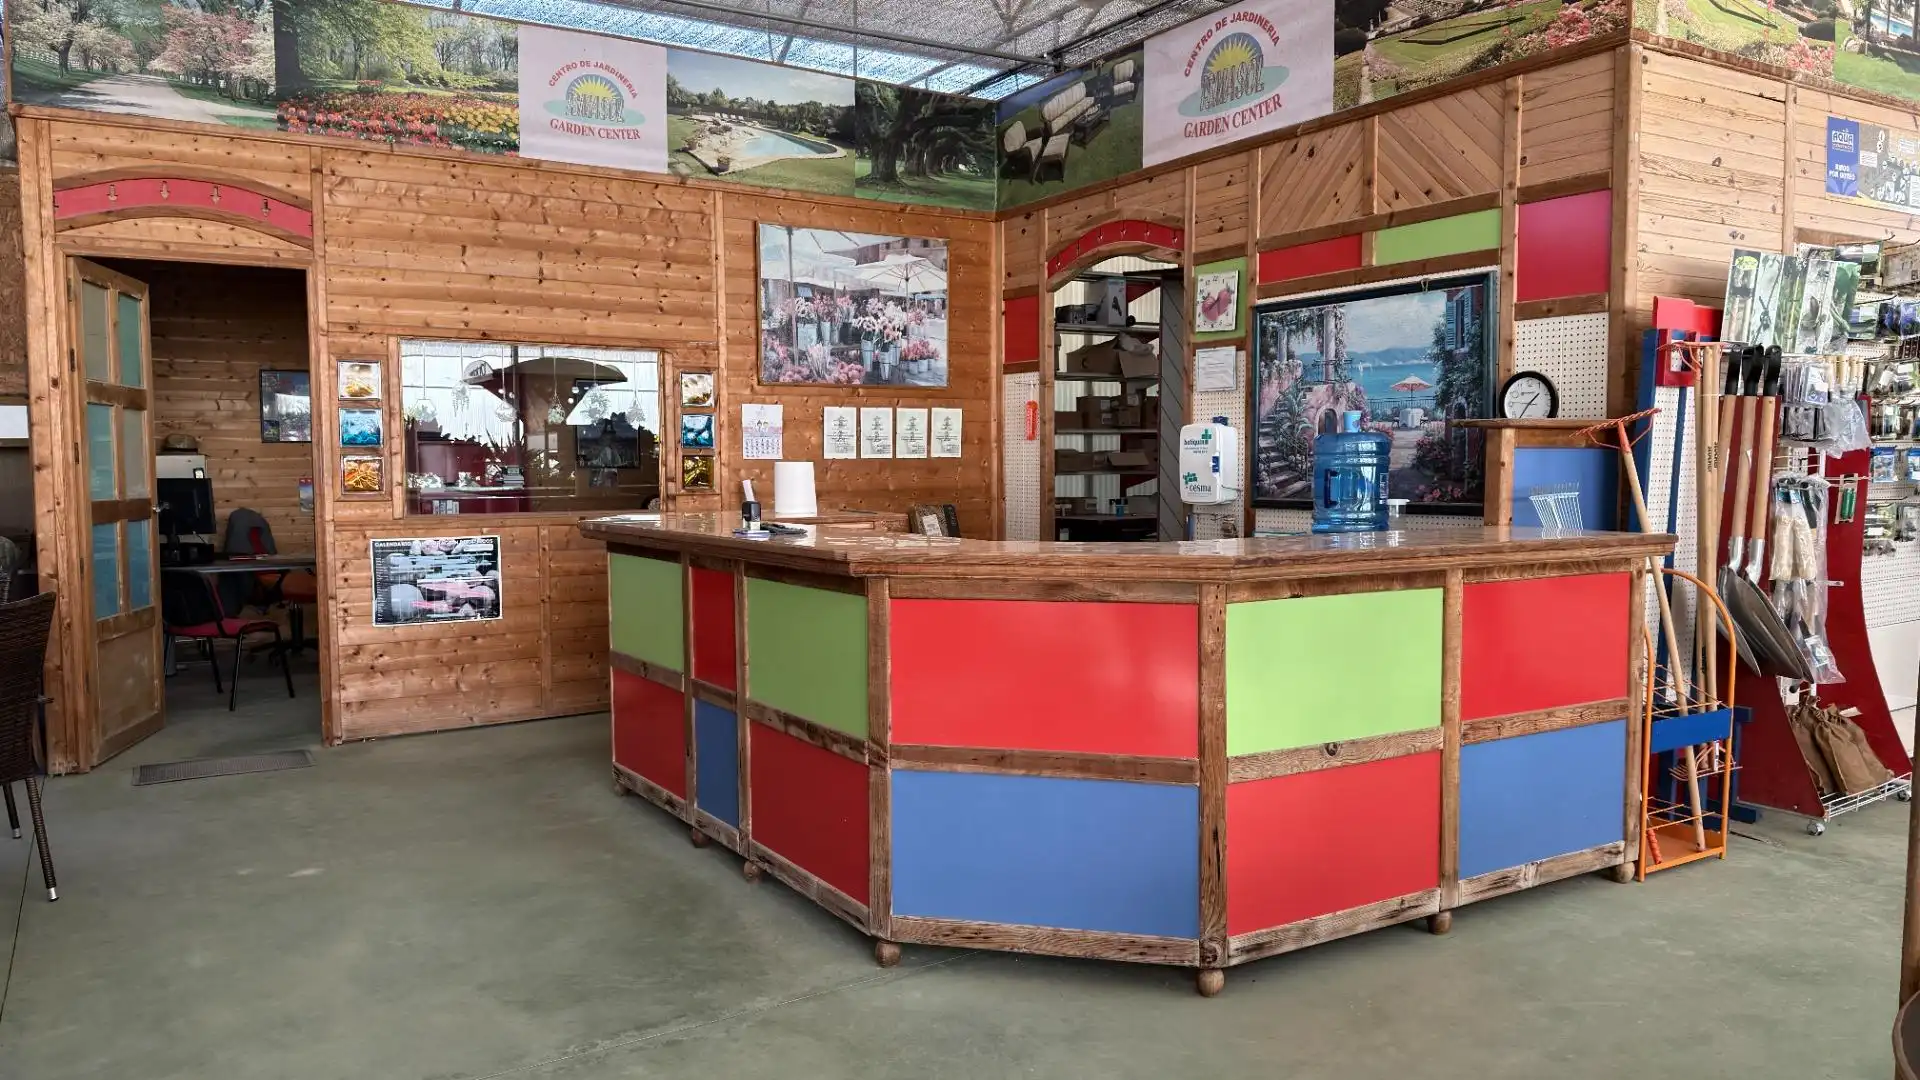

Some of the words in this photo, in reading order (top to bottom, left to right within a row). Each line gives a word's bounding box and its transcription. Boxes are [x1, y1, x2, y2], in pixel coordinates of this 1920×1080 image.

[1184, 29, 1213, 78] CENTRO
[1215, 16, 1228, 31] DE
[1230, 11, 1281, 47] JARDINERIA
[549, 62, 577, 86] CENTRO
[580, 60, 591, 68] DE
[593, 61, 638, 99] JARDINERIA
[550, 118, 595, 137] GARDEN
[598, 127, 641, 140] CENTER
[1184, 116, 1230, 138] GARDEN
[1232, 93, 1283, 129] CENTER
[1832, 131, 1853, 144] AQUA
